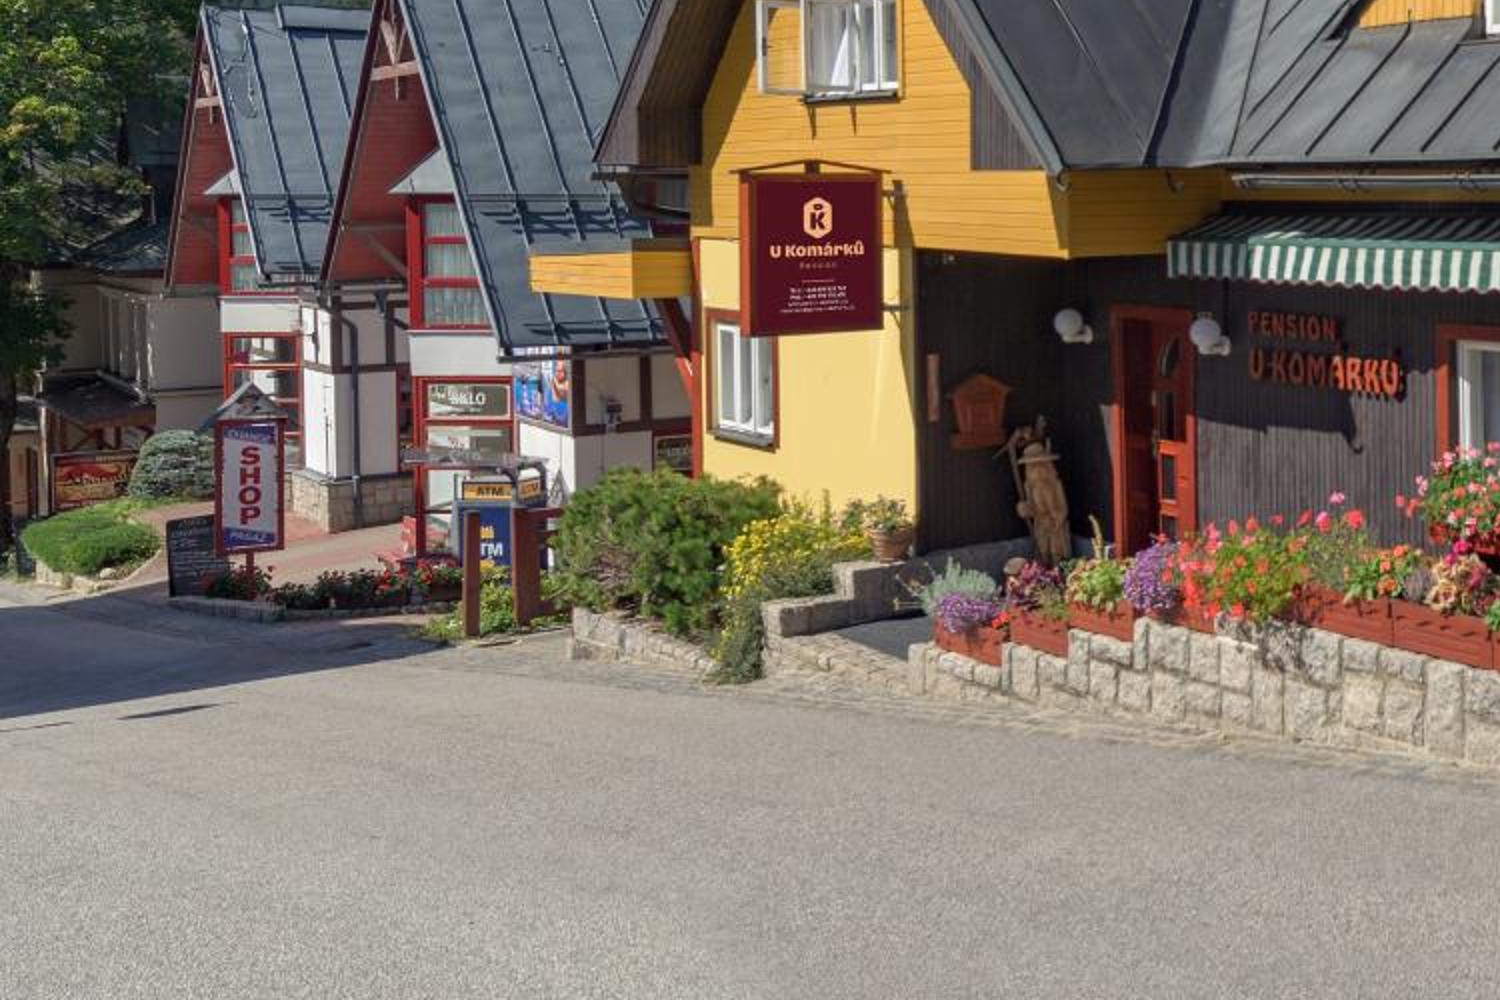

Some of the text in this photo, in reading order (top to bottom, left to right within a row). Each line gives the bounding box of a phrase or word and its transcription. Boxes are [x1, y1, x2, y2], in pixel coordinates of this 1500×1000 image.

[769, 245, 782, 258] U
[1248, 311, 1337, 342] PENSION
[1250, 349, 1264, 380] U
[238, 446, 262, 525] SHOP
[477, 485, 503, 496] ATM
